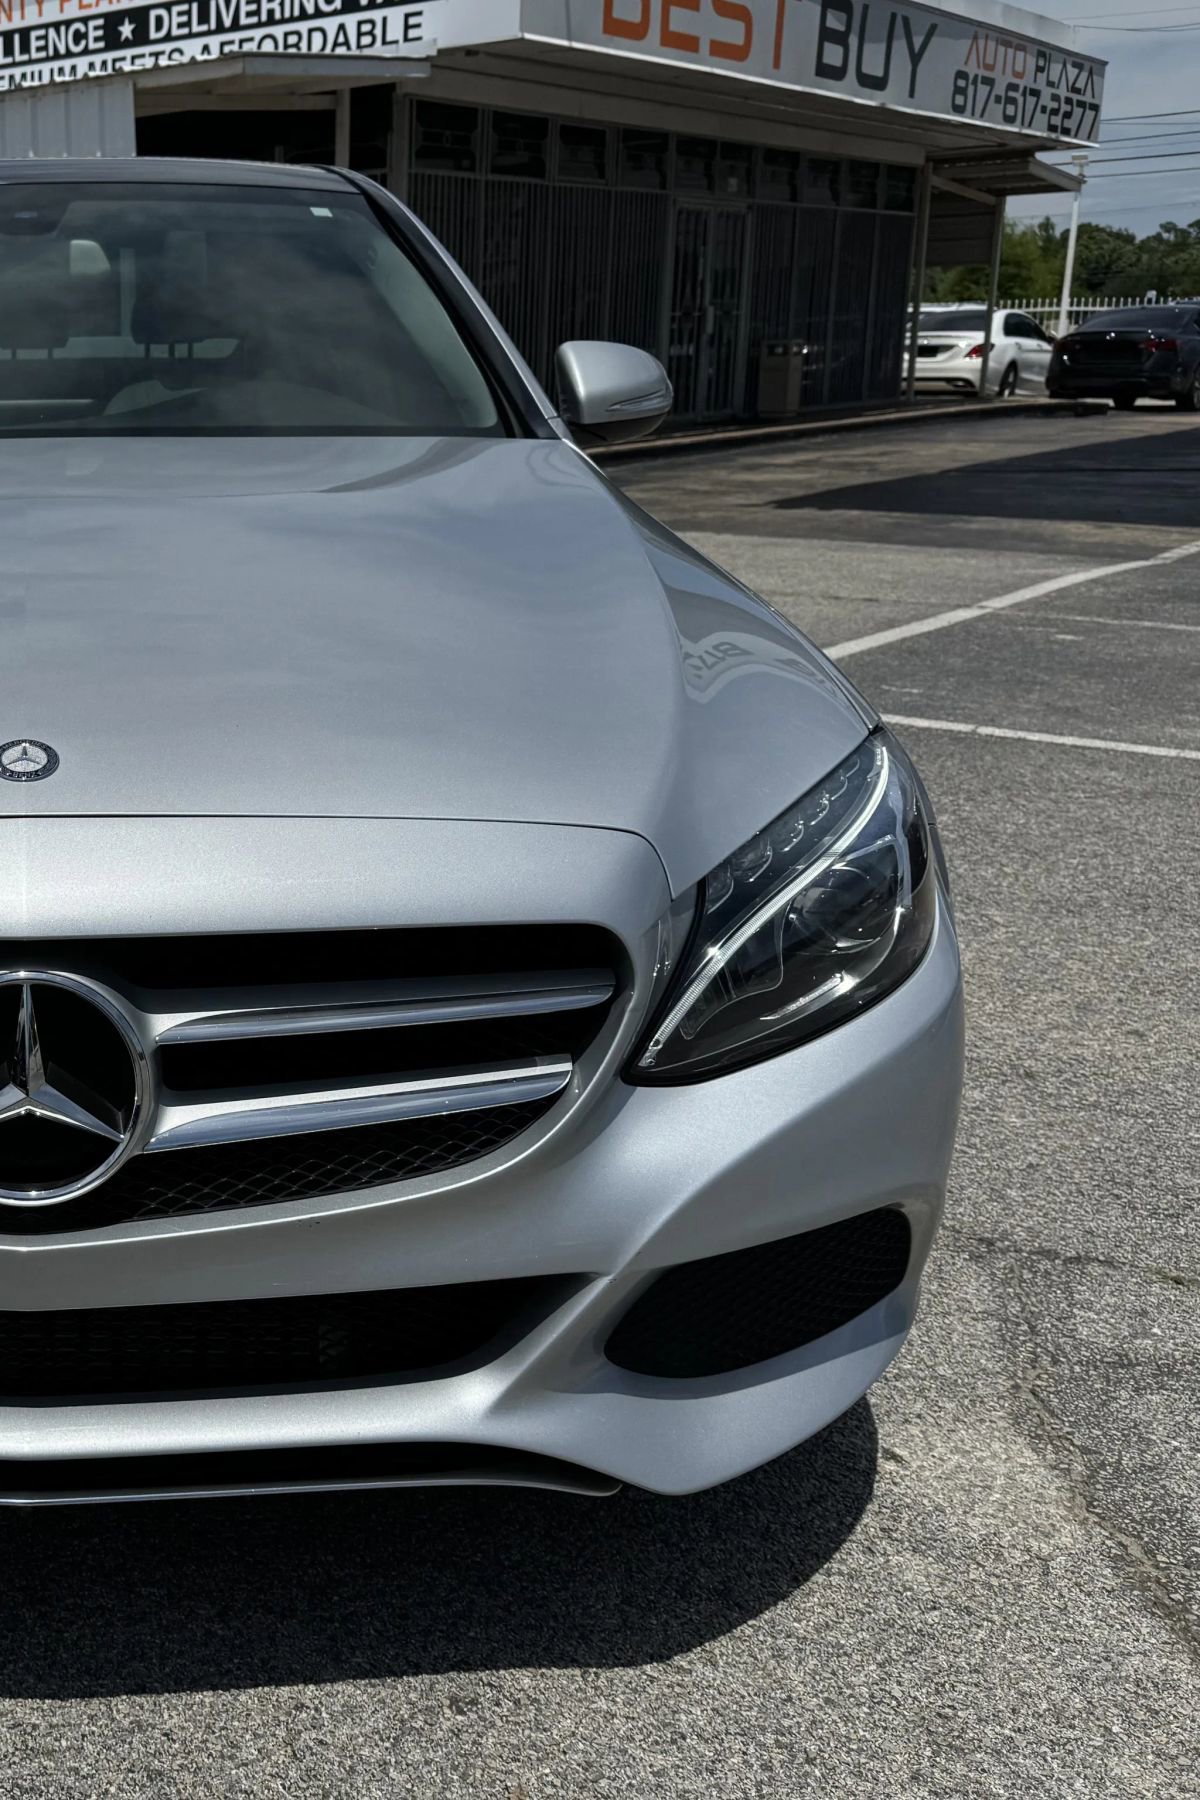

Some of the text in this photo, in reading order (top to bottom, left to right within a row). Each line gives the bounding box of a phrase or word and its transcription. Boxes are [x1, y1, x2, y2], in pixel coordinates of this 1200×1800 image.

[815, 0, 939, 99] BUY
[964, 30, 1096, 99] AUTO PLAZA
[951, 69, 1100, 141] 817-617-2277
